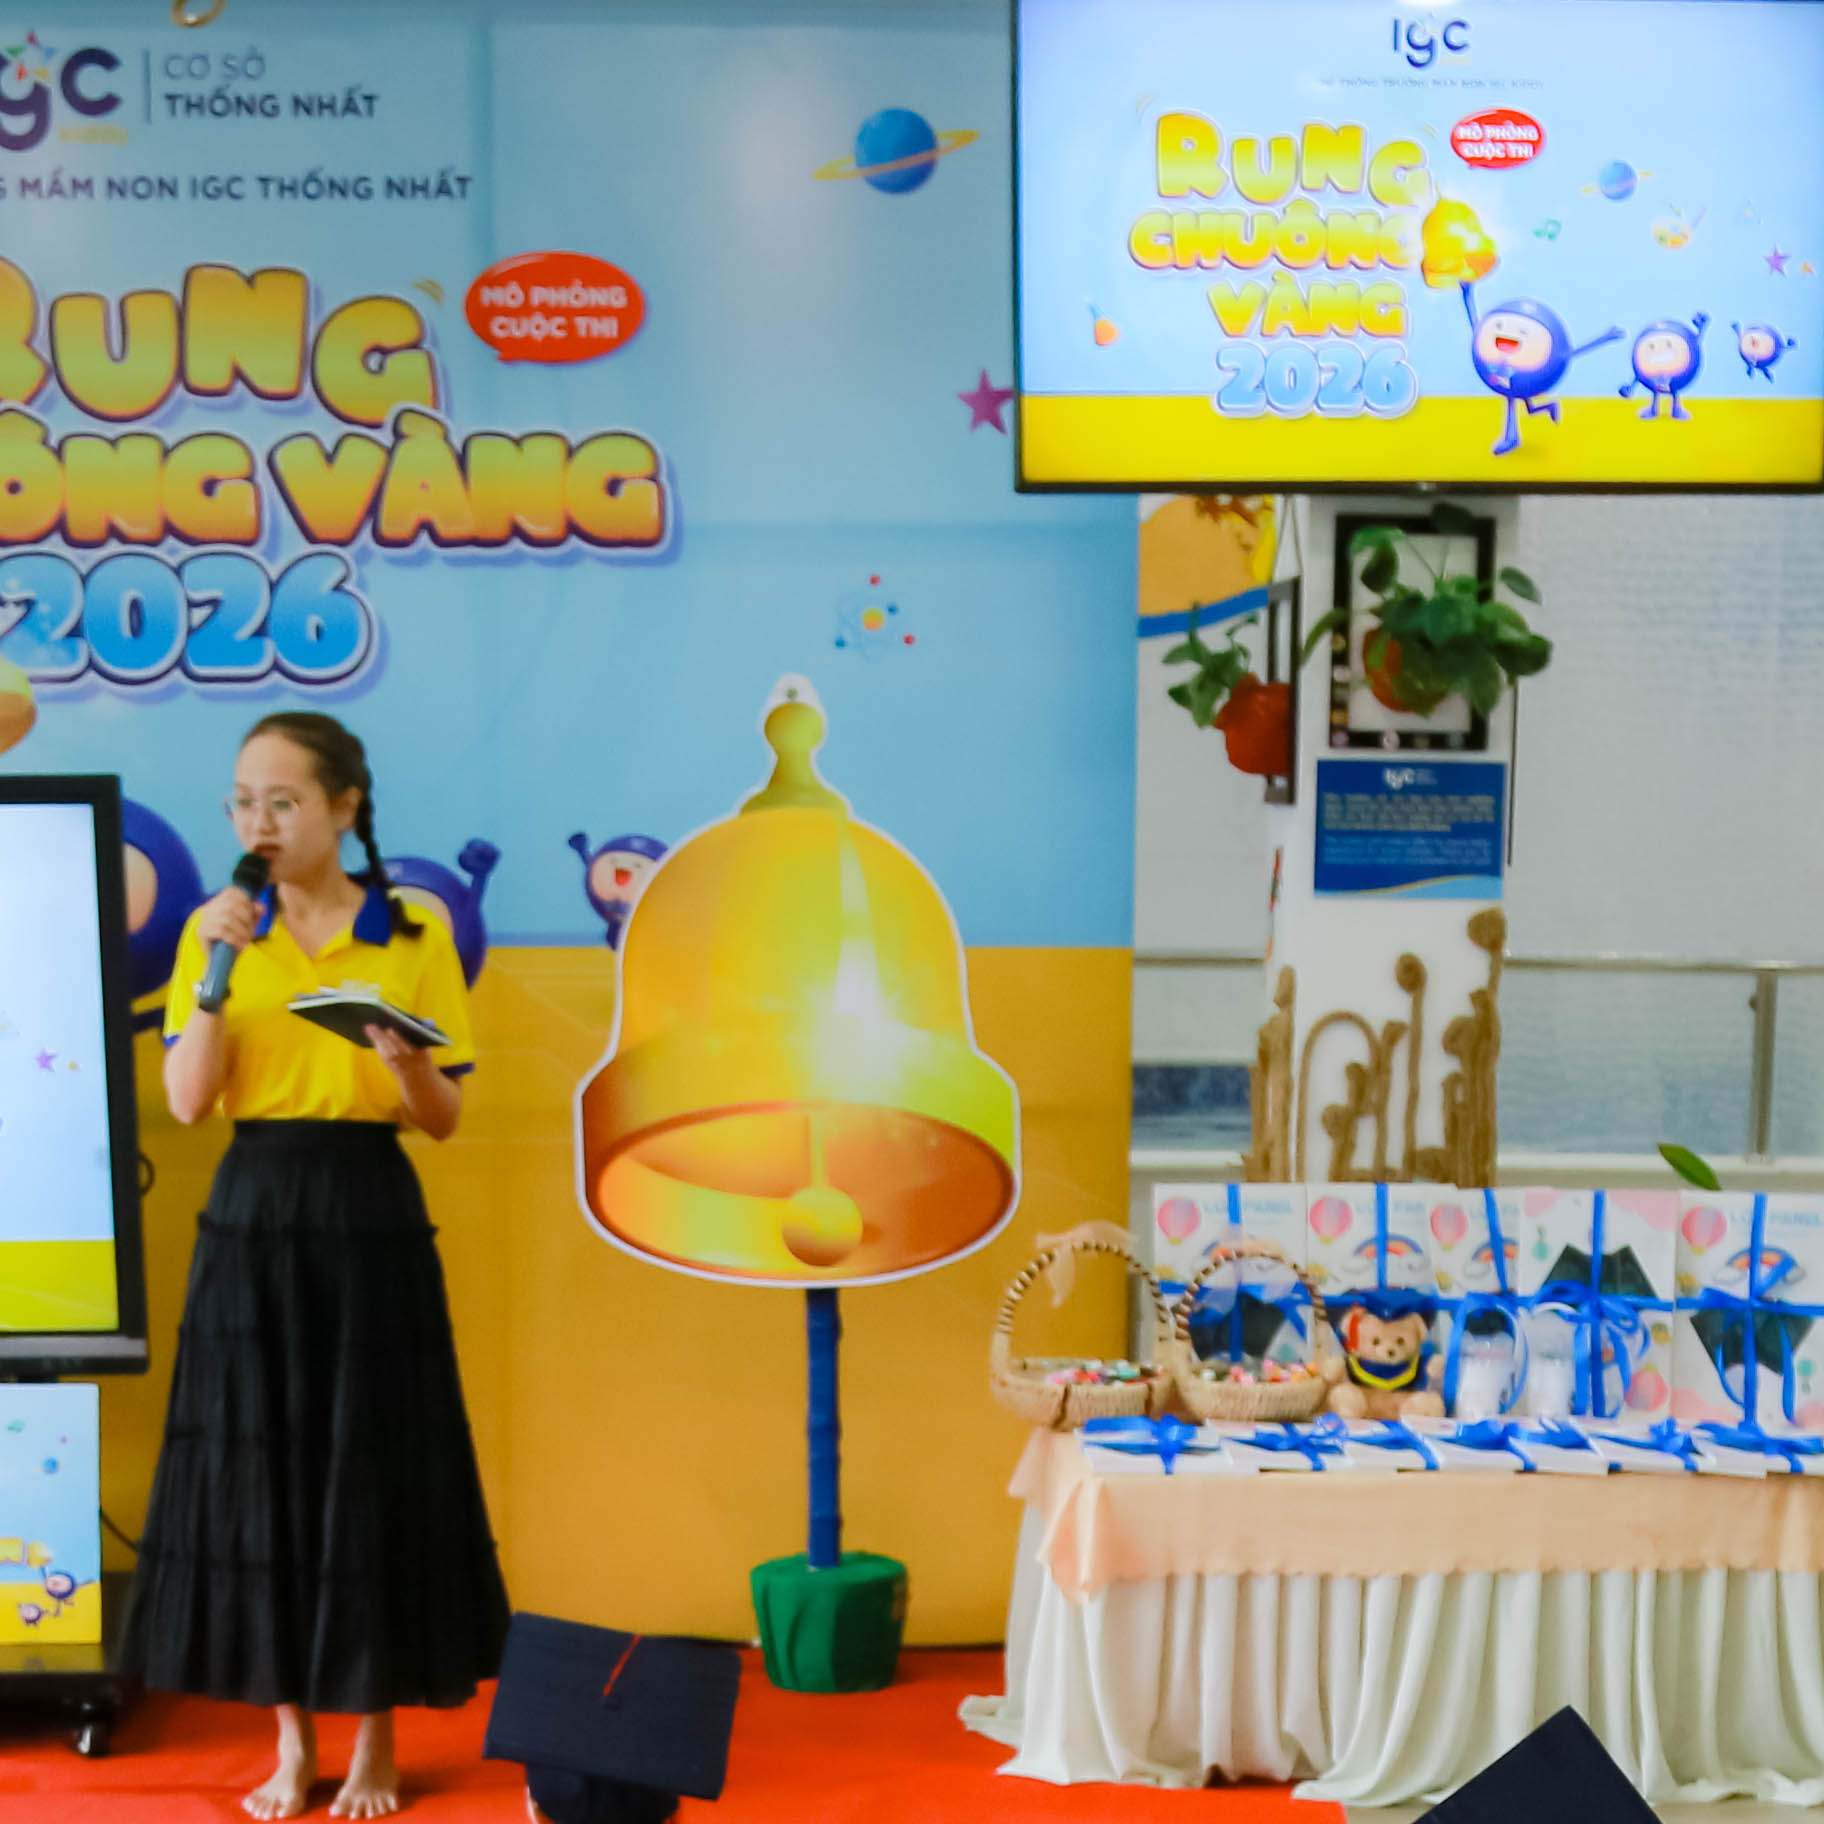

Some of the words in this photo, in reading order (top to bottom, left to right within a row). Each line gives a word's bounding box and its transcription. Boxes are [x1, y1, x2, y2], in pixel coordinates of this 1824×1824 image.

[106, 176, 178, 201] NON
[190, 176, 247, 201] IGC
[480, 280, 525, 309] MÔ
[1207, 270, 1407, 338] VÀNG
[490, 311, 568, 342] CUỘC
[573, 315, 619, 339] THI
[1215, 346, 1416, 413] 2026
[268, 404, 667, 551] VÀNG
